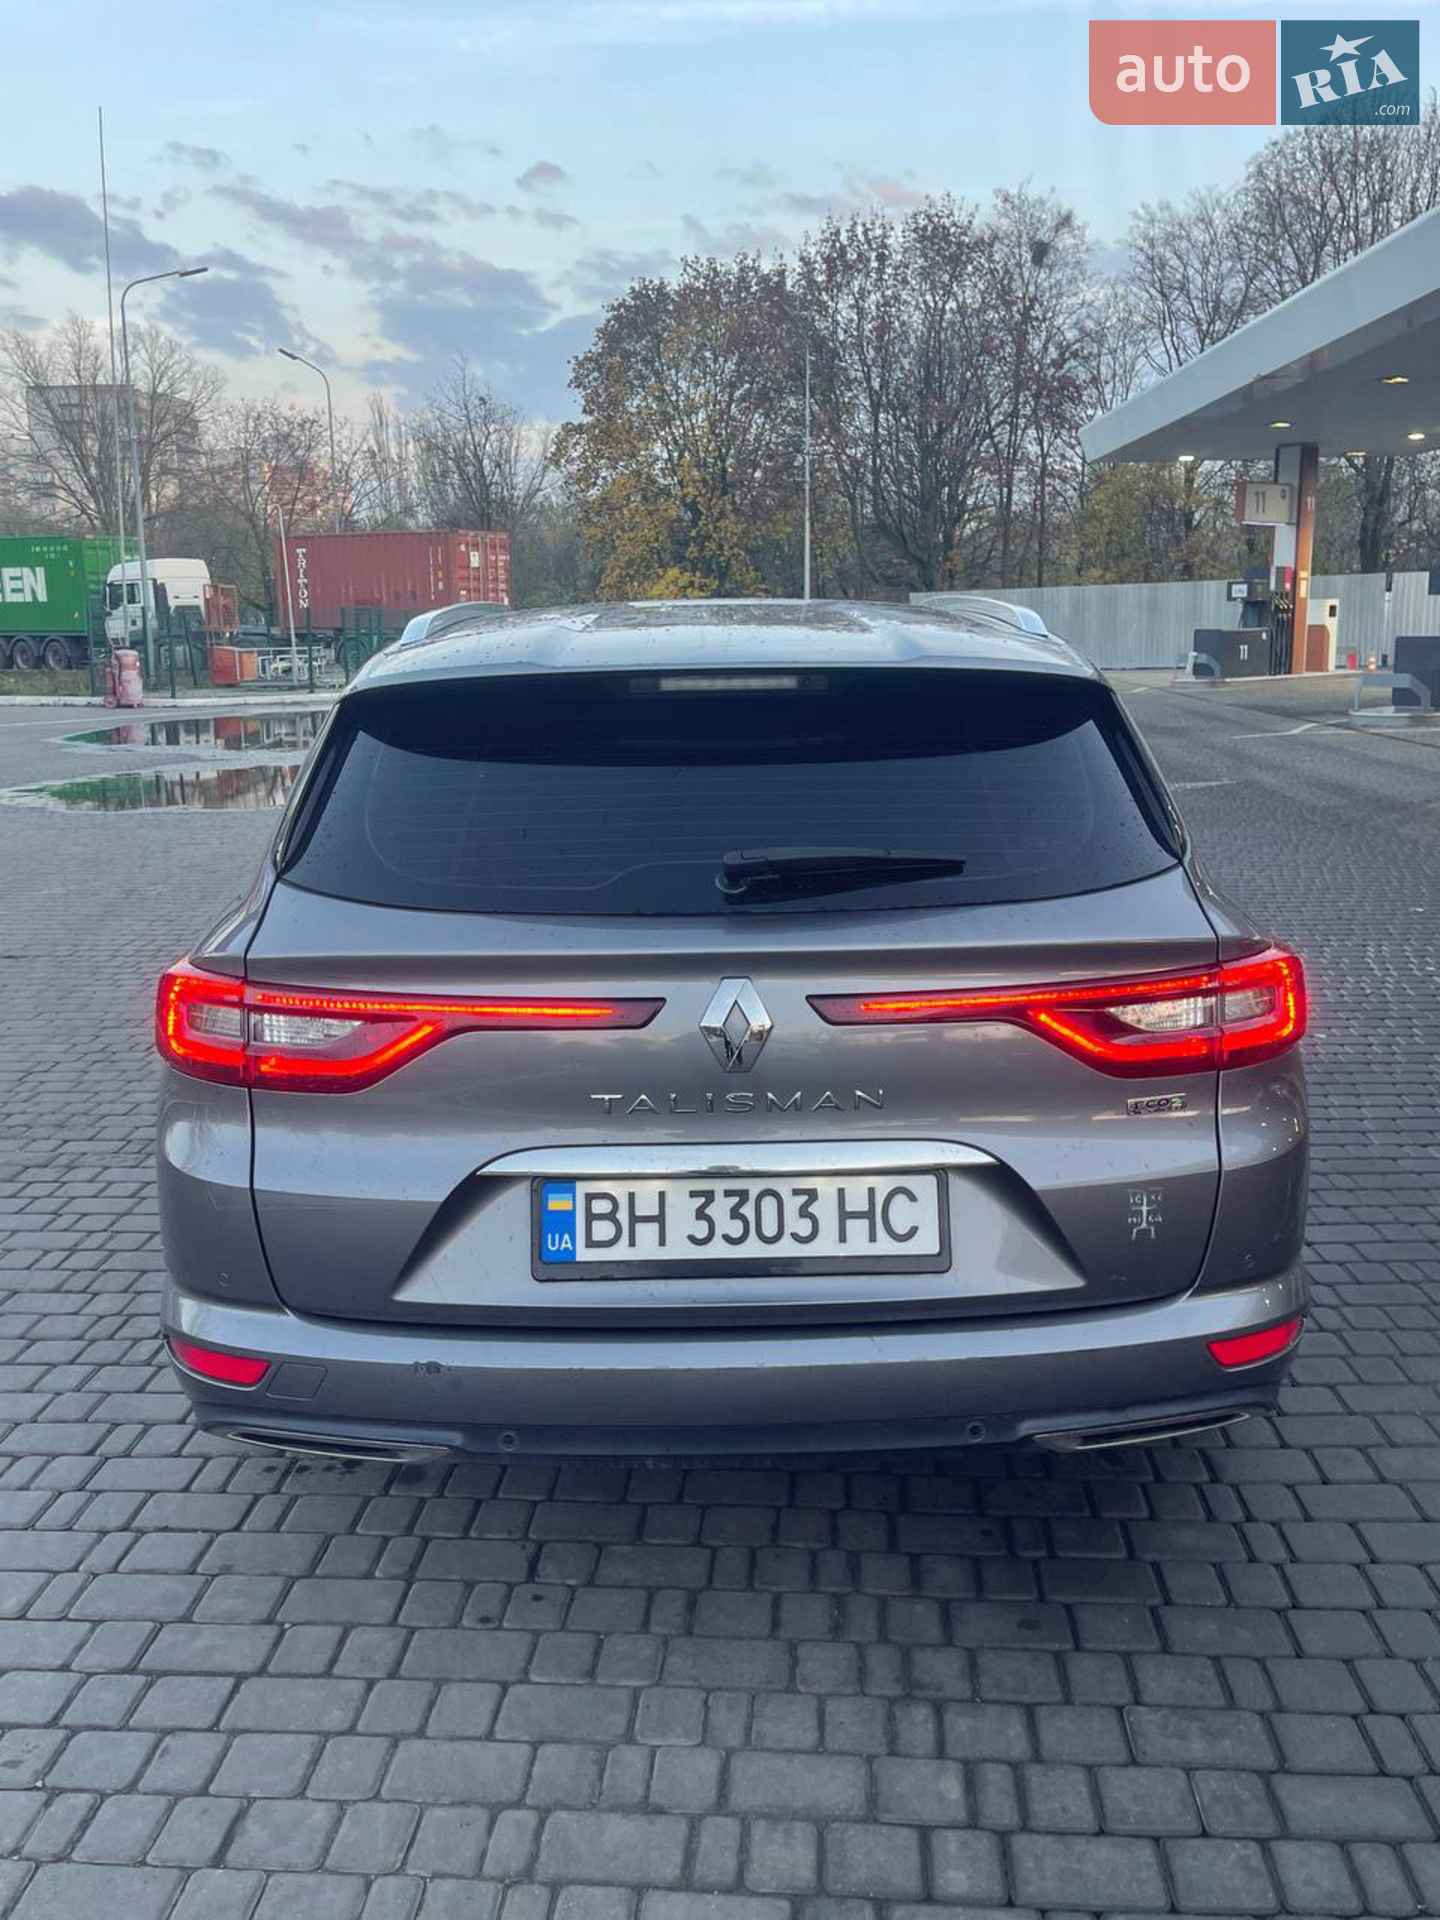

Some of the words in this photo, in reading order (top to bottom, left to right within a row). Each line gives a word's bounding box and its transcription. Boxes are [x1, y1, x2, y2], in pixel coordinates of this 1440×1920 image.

[0, 566, 48, 602] EN
[295, 548, 309, 609] TRITON
[590, 1089, 886, 1116] TALISMAN
[584, 1191, 668, 1249] BH
[686, 1187, 820, 1246] 3303
[837, 1186, 919, 1243] HC
[547, 1233, 573, 1251] UA
